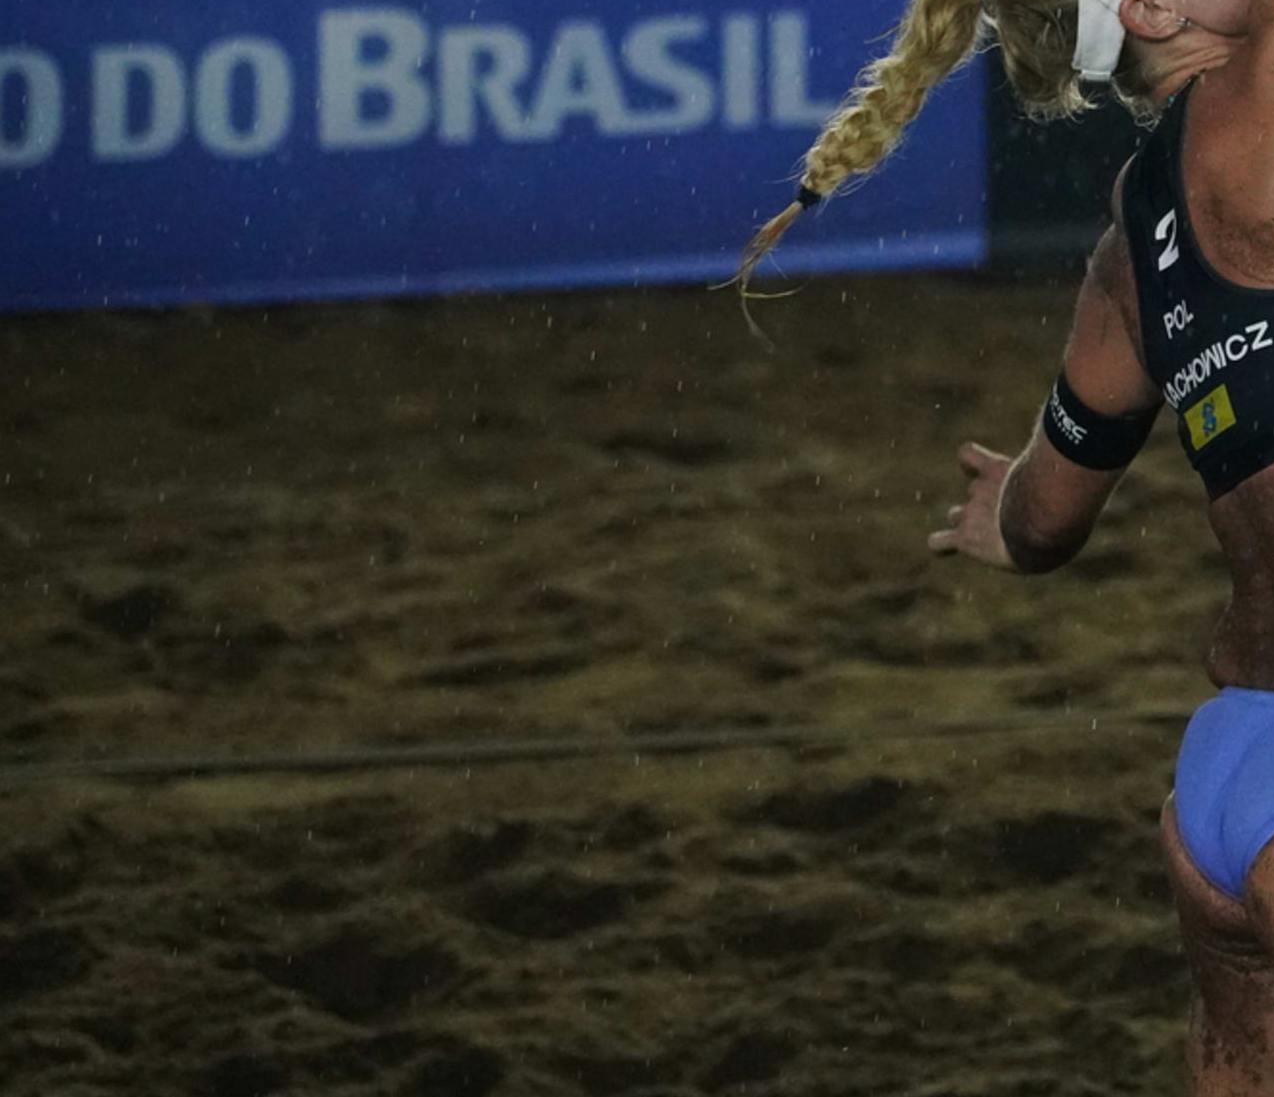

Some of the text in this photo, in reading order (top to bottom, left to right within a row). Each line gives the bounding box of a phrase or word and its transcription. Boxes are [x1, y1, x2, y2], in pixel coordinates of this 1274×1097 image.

[91, 36, 294, 161] DO
[317, 7, 846, 151] BRASIL
[1155, 208, 1180, 272] 2
[1163, 300, 1194, 340] POL
